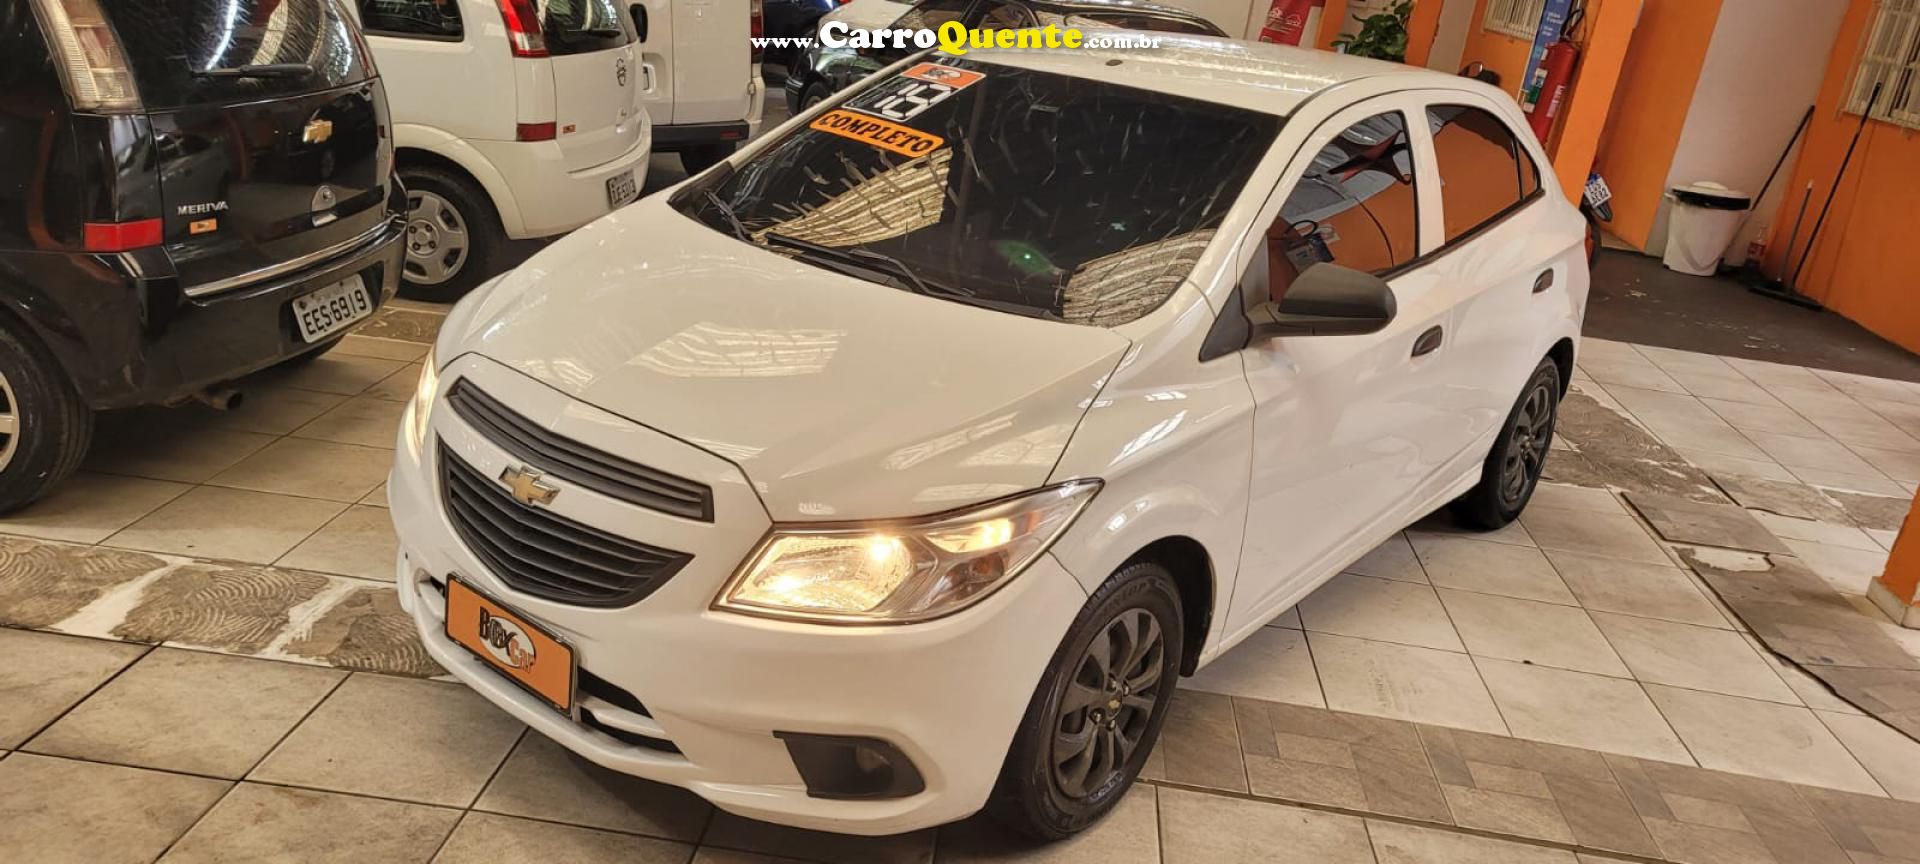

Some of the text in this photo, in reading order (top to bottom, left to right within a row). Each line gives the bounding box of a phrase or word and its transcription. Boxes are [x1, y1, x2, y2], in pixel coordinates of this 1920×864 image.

[873, 82, 952, 120] 18
[818, 113, 935, 152] COMPLETO
[177, 201, 229, 215] MERIVA
